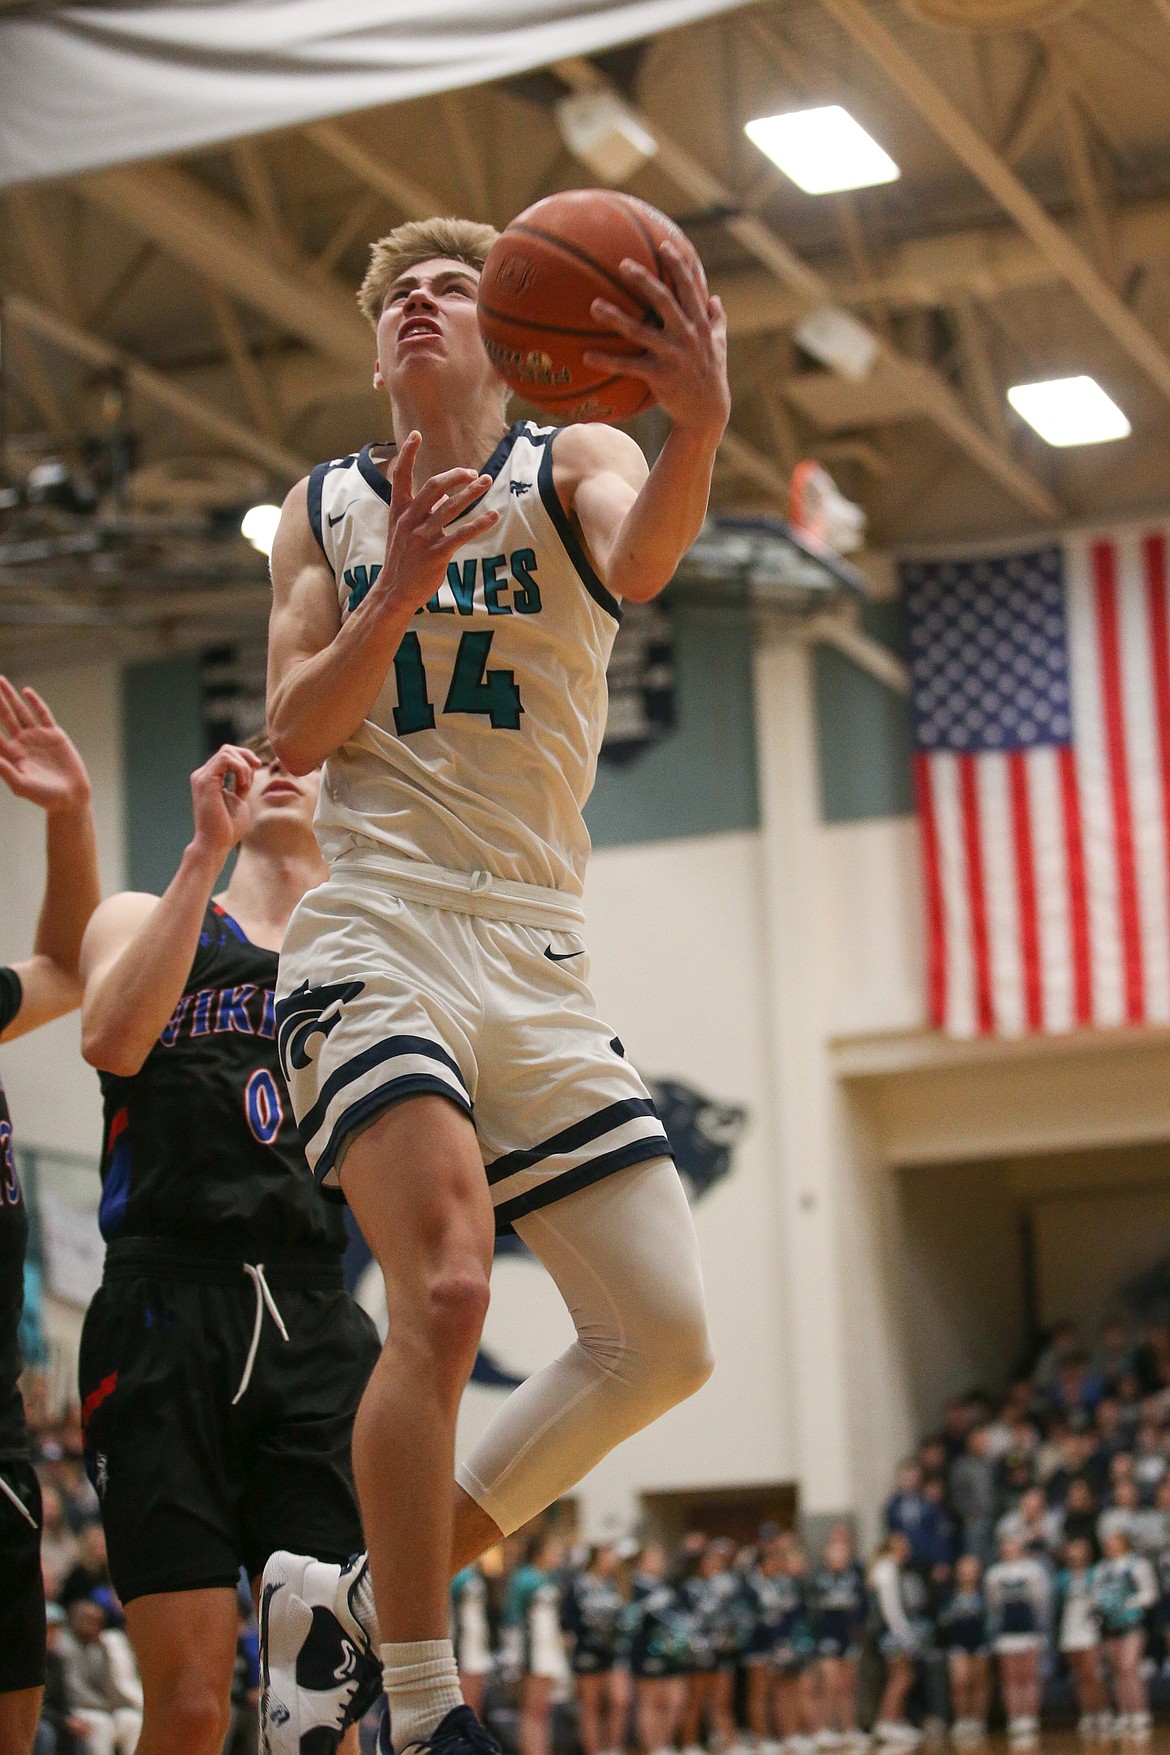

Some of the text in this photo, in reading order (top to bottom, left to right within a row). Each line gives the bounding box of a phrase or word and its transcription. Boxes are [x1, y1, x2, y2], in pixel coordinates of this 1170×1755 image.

[343, 547, 542, 616] WLVES
[392, 630, 525, 737] 14
[244, 1067, 284, 1145] 0
[0, 1120, 20, 1205] 3
